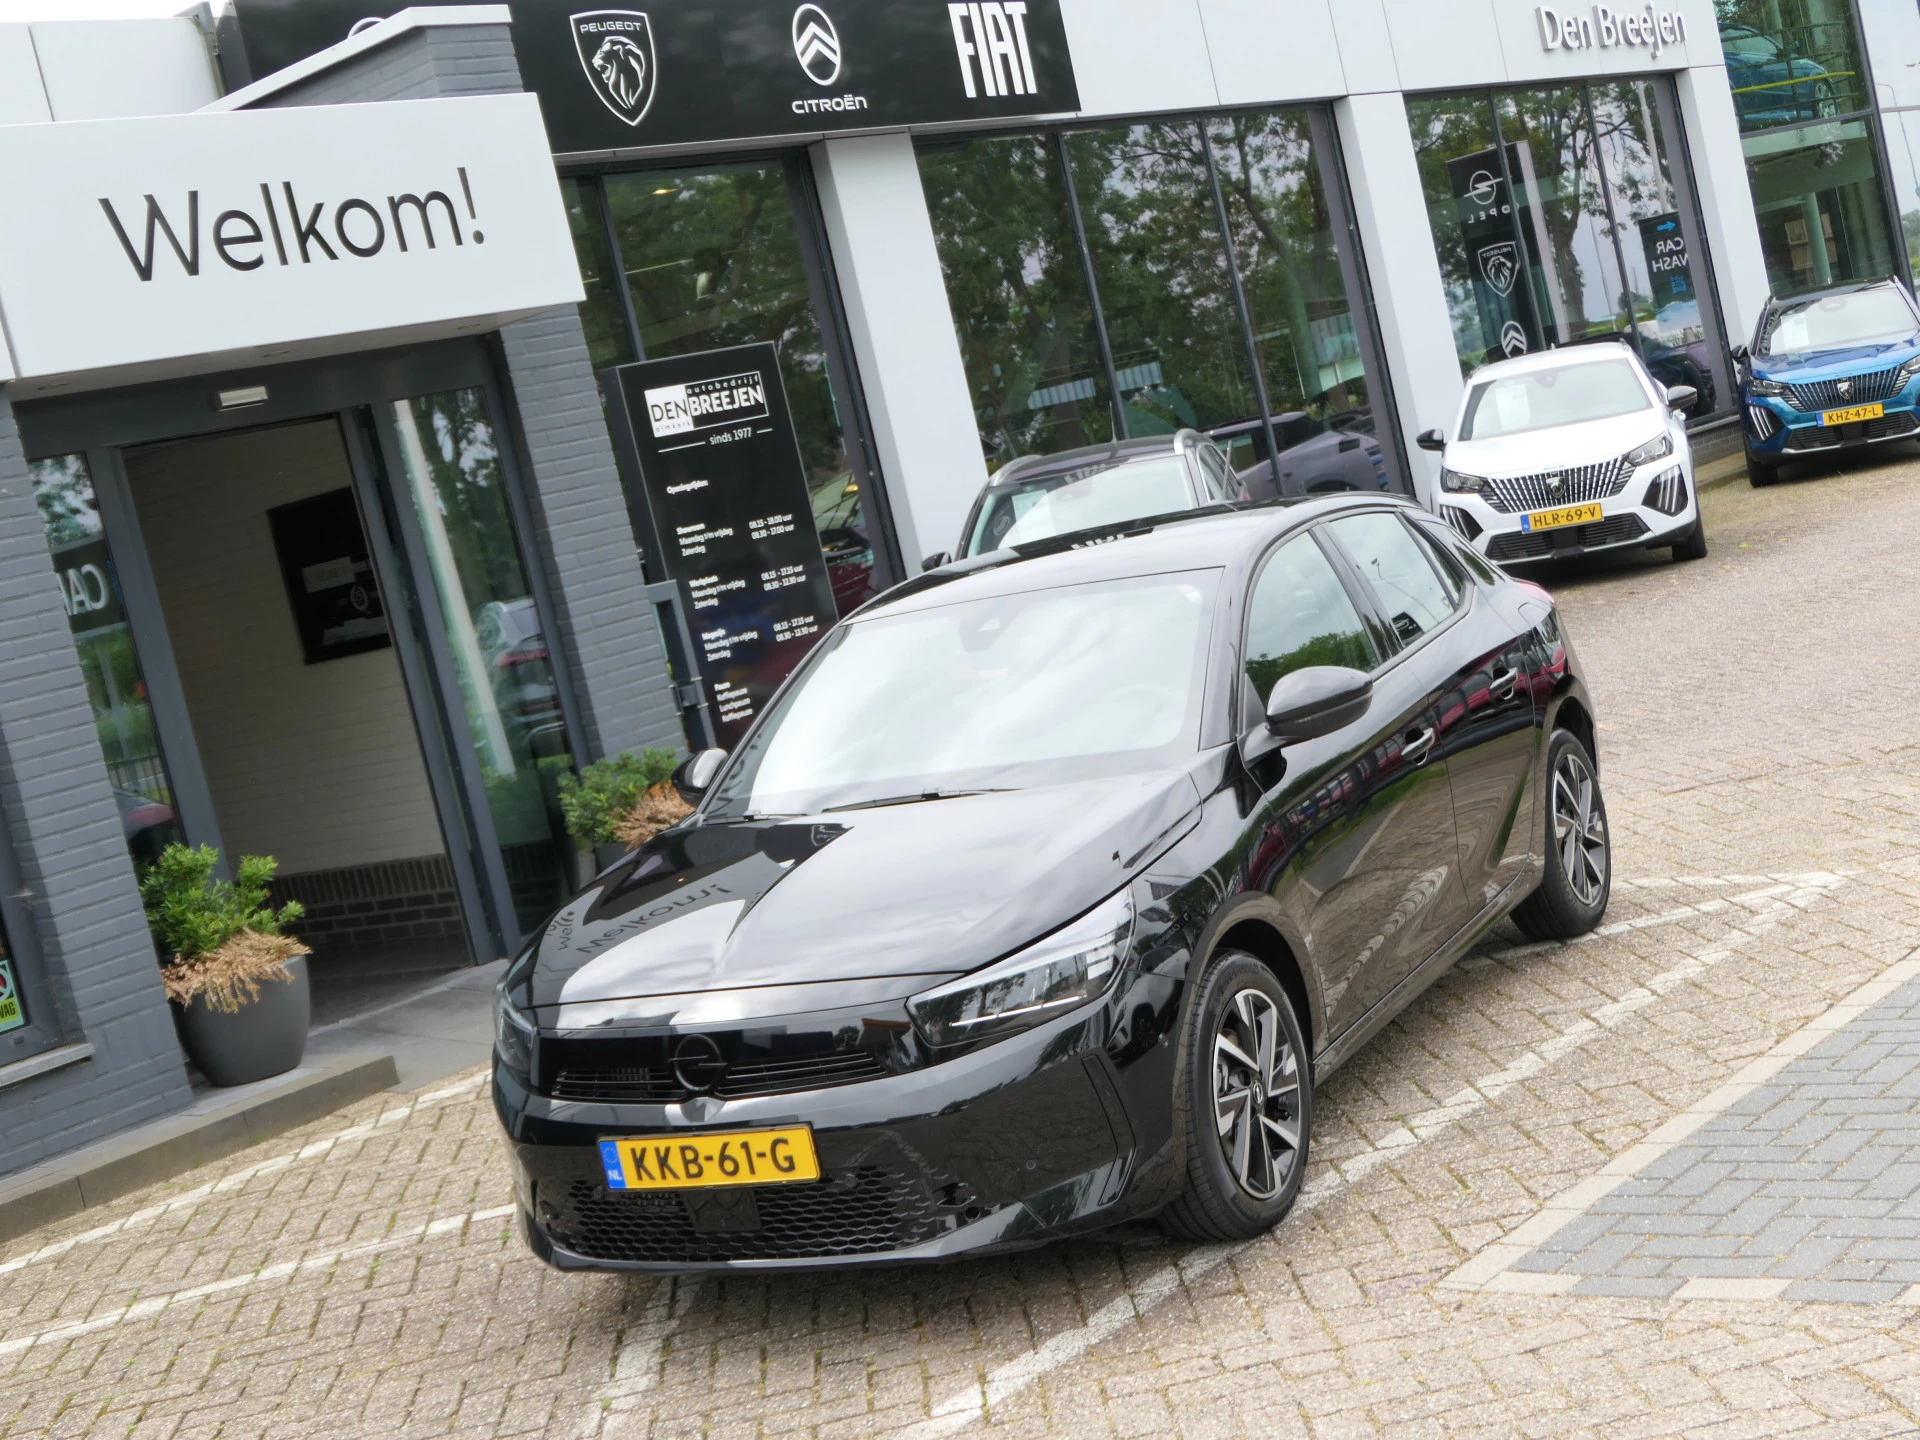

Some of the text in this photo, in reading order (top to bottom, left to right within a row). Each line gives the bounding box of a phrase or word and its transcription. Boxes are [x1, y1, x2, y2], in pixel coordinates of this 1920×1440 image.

[580, 20, 642, 34] PEUGEOT
[1535, 2, 1688, 59] Den Breejen
[947, 1, 1038, 99] FIAT
[98, 166, 486, 282] Welkom!
[686, 374, 760, 395] autobedrijf
[651, 385, 764, 422] DEN BREEJEN
[1828, 407, 1879, 422] KHZ-47-L
[709, 427, 752, 445] sinds 1977
[1533, 506, 1596, 528] HLR-69-V
[808, 625, 818, 633] uur
[630, 1137, 796, 1181] KKB-61-G
[607, 1169, 623, 1181] NL
